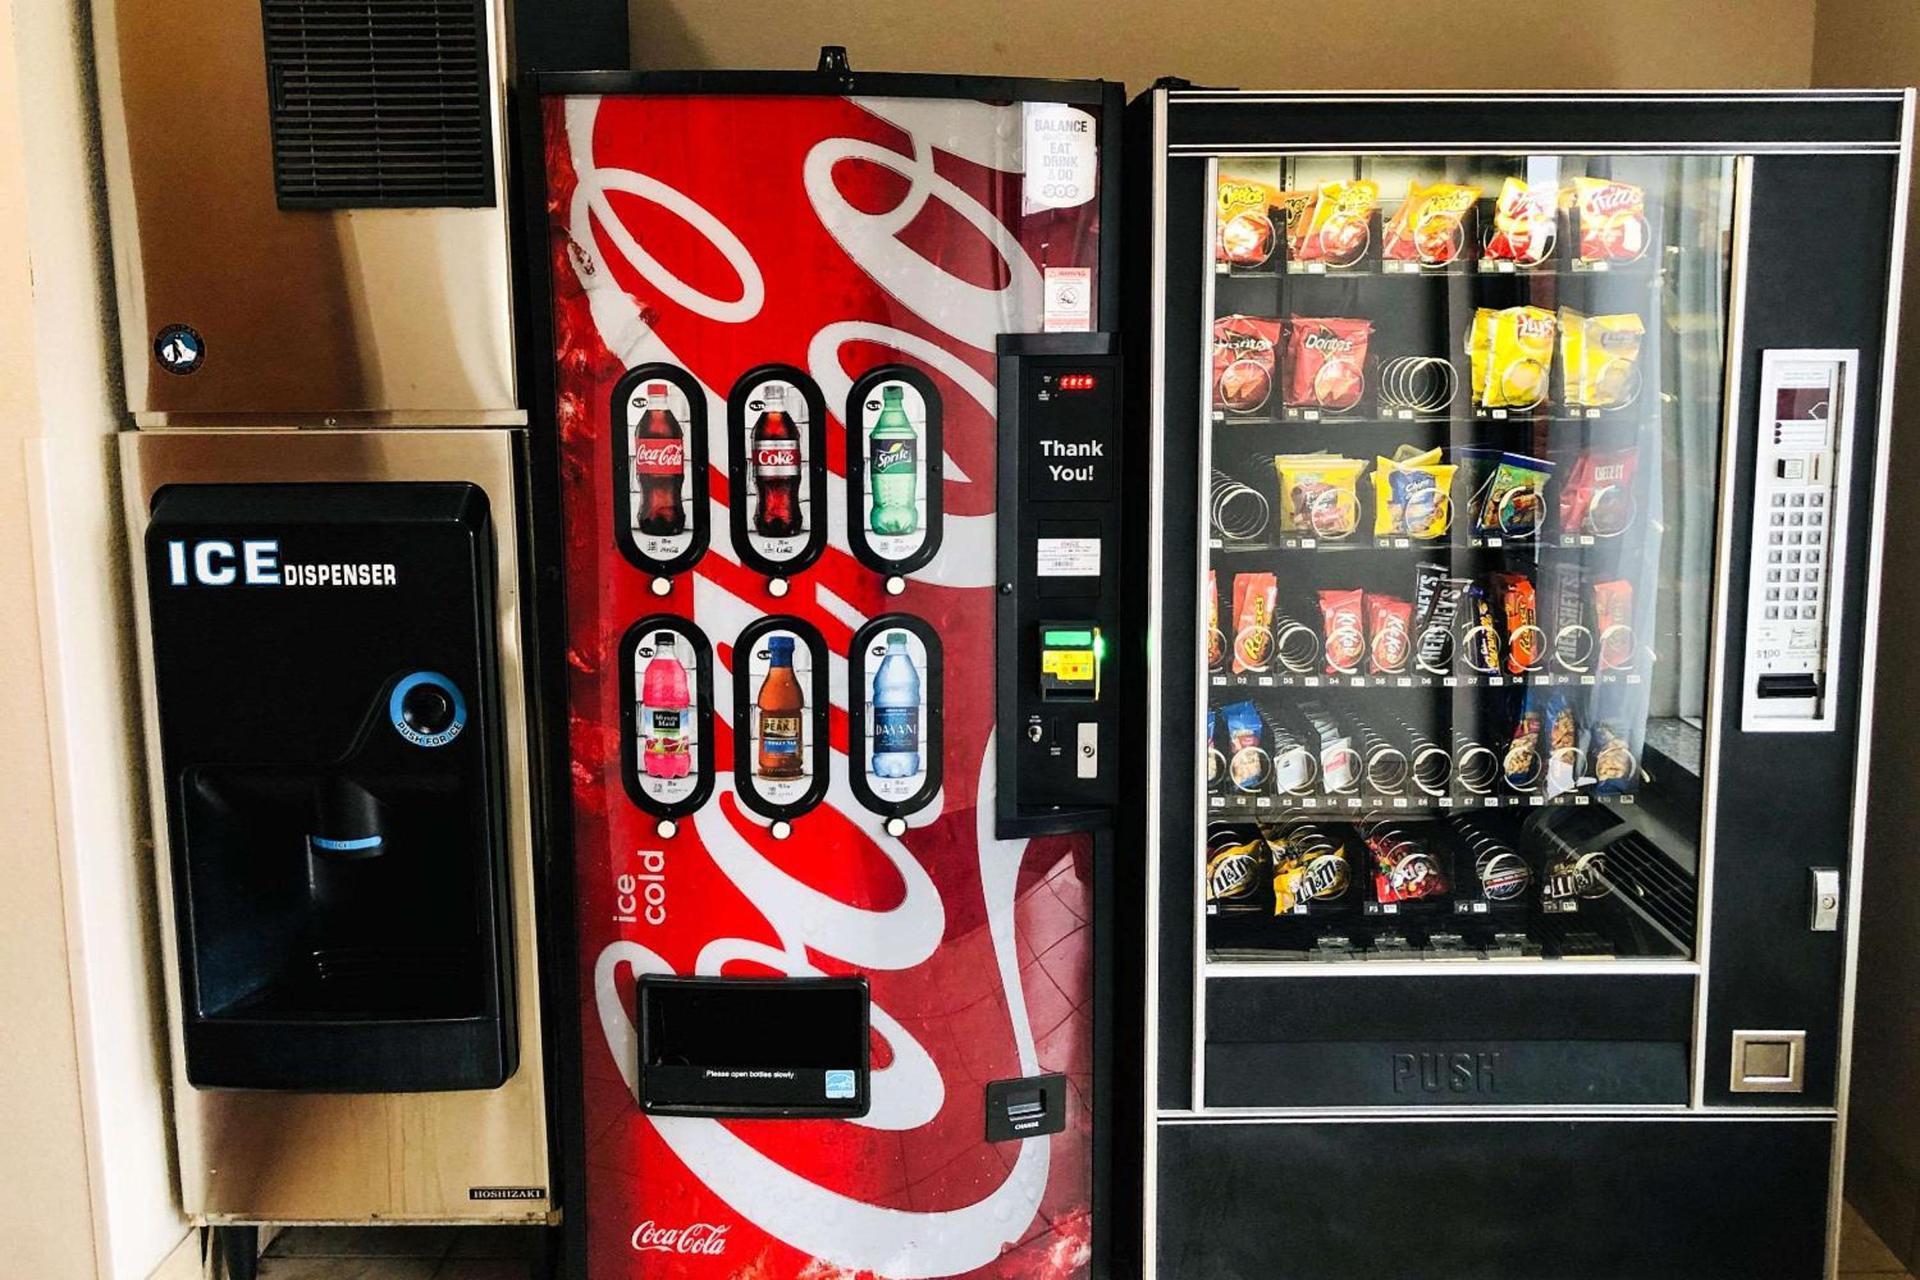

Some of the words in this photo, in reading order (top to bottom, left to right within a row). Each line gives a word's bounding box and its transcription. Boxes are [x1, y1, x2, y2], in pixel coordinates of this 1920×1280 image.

[1035, 119, 1088, 132] BALANCE
[1049, 143, 1072, 154] EAT
[1043, 156, 1079, 167] DRINK
[1058, 168, 1074, 180] DO
[1305, 334, 1353, 352] Doritos
[636, 444, 683, 466] Coca-Cola
[1040, 440, 1103, 457] Thank
[758, 450, 794, 465] Coke
[878, 448, 910, 468] Sprite
[1049, 465, 1094, 481] You!
[168, 540, 280, 586] ICE
[285, 563, 397, 586] DISPENSER
[397, 721, 423, 743] PUSH
[426, 735, 447, 745] FOR
[448, 721, 464, 738] ICE
[764, 722, 789, 731] PEAK
[637, 850, 666, 925] cold
[613, 874, 637, 922] ice
[773, 1070, 794, 1079] slowly
[1392, 1052, 1500, 1094] PUSH
[474, 1189, 541, 1199] HOSHIZAKI
[631, 1220, 732, 1256] Coca-Cola
